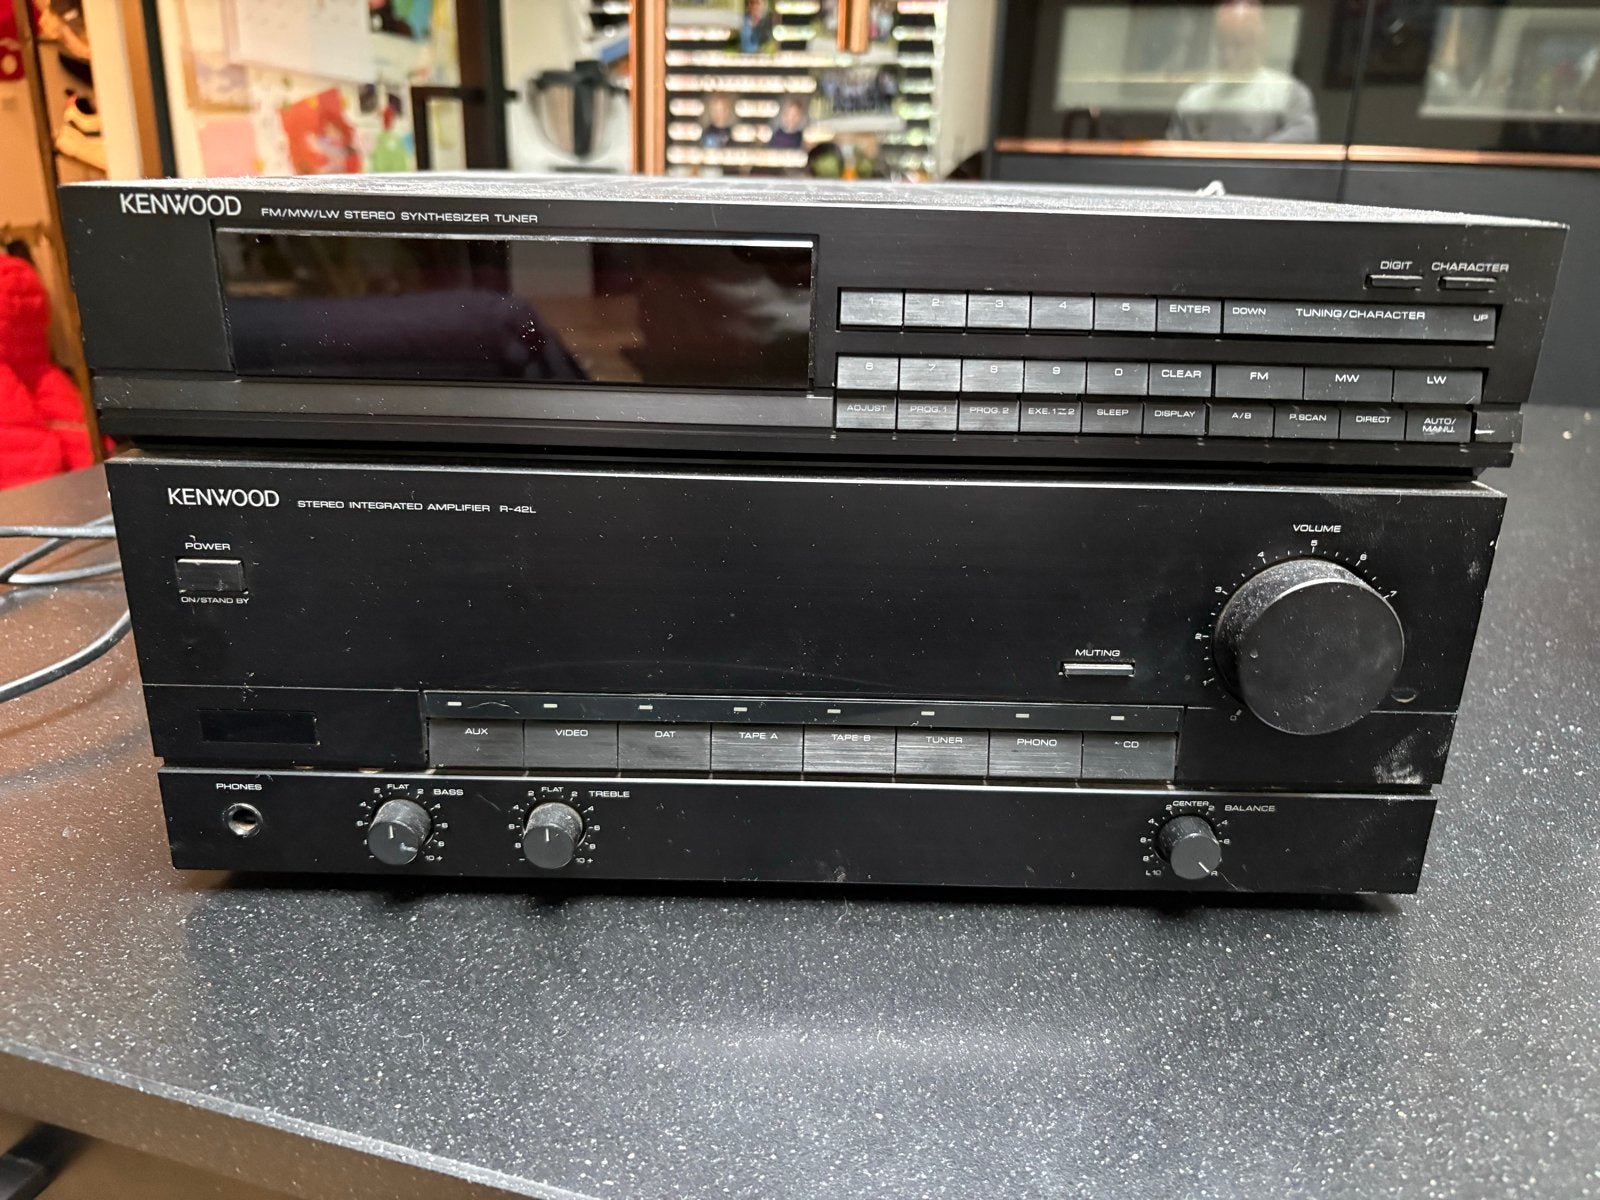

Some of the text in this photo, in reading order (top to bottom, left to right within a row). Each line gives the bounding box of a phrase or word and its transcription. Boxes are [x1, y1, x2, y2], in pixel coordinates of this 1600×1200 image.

[120, 192, 242, 216] KENWOOD
[260, 208, 539, 224] FM/MW/LW STEREO SYNTHESIZER TUNER
[1380, 260, 1413, 271] DIGIT
[1431, 261, 1510, 273] CHARACTER
[868, 296, 875, 306] 1
[932, 298, 941, 307] 2
[995, 299, 1004, 308] 3
[1058, 300, 1068, 310] 4
[1122, 302, 1131, 312] 5
[1169, 304, 1211, 315] ENTER
[1232, 306, 1267, 316] DOWN
[1295, 308, 1426, 321] TUNING/CHARACTER
[1472, 313, 1489, 323] UP
[865, 362, 874, 371] 6
[928, 364, 936, 372] 7
[990, 365, 999, 374] 8
[1052, 366, 1061, 376] 9
[1114, 368, 1123, 377] 0
[1161, 369, 1202, 379] CLEAR
[1250, 371, 1270, 381] FM
[1334, 374, 1360, 383] MW
[1426, 375, 1447, 385] LW
[846, 404, 887, 413] ADJUST
[1096, 408, 1129, 417] SLEEP
[1154, 410, 1196, 419] DISPLAY
[1231, 411, 1252, 420] A/B
[1289, 412, 1327, 422] P.SCAN
[1356, 414, 1392, 424] DIRECT
[1424, 417, 1457, 426] AUTO/
[167, 487, 280, 508] KENWOOD
[297, 500, 537, 514] STEREO INTEGRATED AMPLIFIER R-42L
[1292, 524, 1342, 534] VOLUME
[184, 542, 232, 552] POWER
[1310, 539, 1319, 547] 5
[1359, 554, 1368, 562] 6
[1214, 586, 1223, 594] 3
[1390, 590, 1398, 598] 7
[180, 596, 250, 605] ON/STAND BY
[1194, 632, 1203, 641] 2
[1074, 648, 1122, 658] MUTING
[464, 727, 489, 736] AUX
[555, 728, 589, 738] VIDEO
[654, 730, 677, 739] DAT
[738, 732, 779, 740] TAPE A
[831, 733, 872, 742] TAPE B
[926, 736, 964, 745] TUNER
[1016, 738, 1058, 747] PHONO
[1122, 740, 1140, 749] CD
[216, 782, 263, 791] PHONES
[433, 788, 464, 796] BASS
[588, 790, 631, 798] TREBLE
[1208, 804, 1215, 812] 2
[1224, 804, 1276, 813] BALANCE
